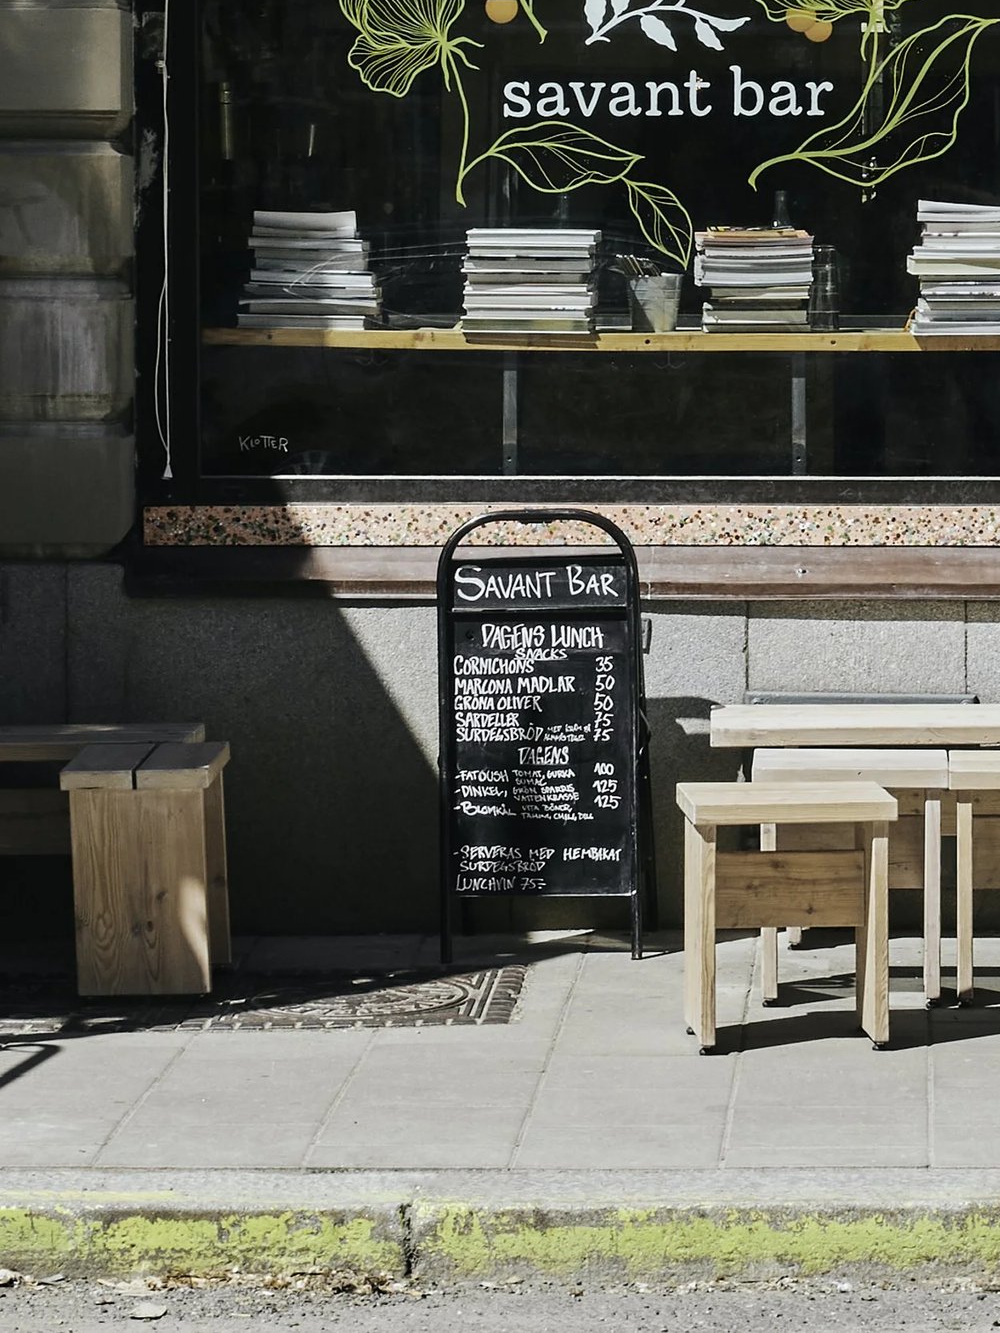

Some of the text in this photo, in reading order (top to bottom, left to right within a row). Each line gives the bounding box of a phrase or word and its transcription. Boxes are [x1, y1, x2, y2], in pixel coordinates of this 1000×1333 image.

[503, 64, 835, 118] savant bar
[239, 435, 289, 452] KLOTTER
[454, 565, 618, 602] SAVANT BAR
[481, 623, 604, 650] DAGENS LUNCH
[514, 648, 568, 660] SNACKS
[453, 654, 614, 675] CORNICHONS 35
[454, 676, 513, 696] MARCONA
[595, 674, 616, 692] 50
[496, 694, 543, 713] OLIVER
[593, 692, 614, 711] 50
[455, 711, 614, 728] SARDELLER 75
[456, 723, 544, 742] SURDEGSBRÖD
[593, 728, 614, 742] 75
[517, 746, 570, 765] DAGENS
[547, 768, 576, 779] GURKA
[593, 762, 615, 776] 100
[592, 779, 619, 794] 125
[593, 795, 622, 810] 125
[529, 847, 556, 860] MED
[456, 874, 516, 892] LUNCHVIN
